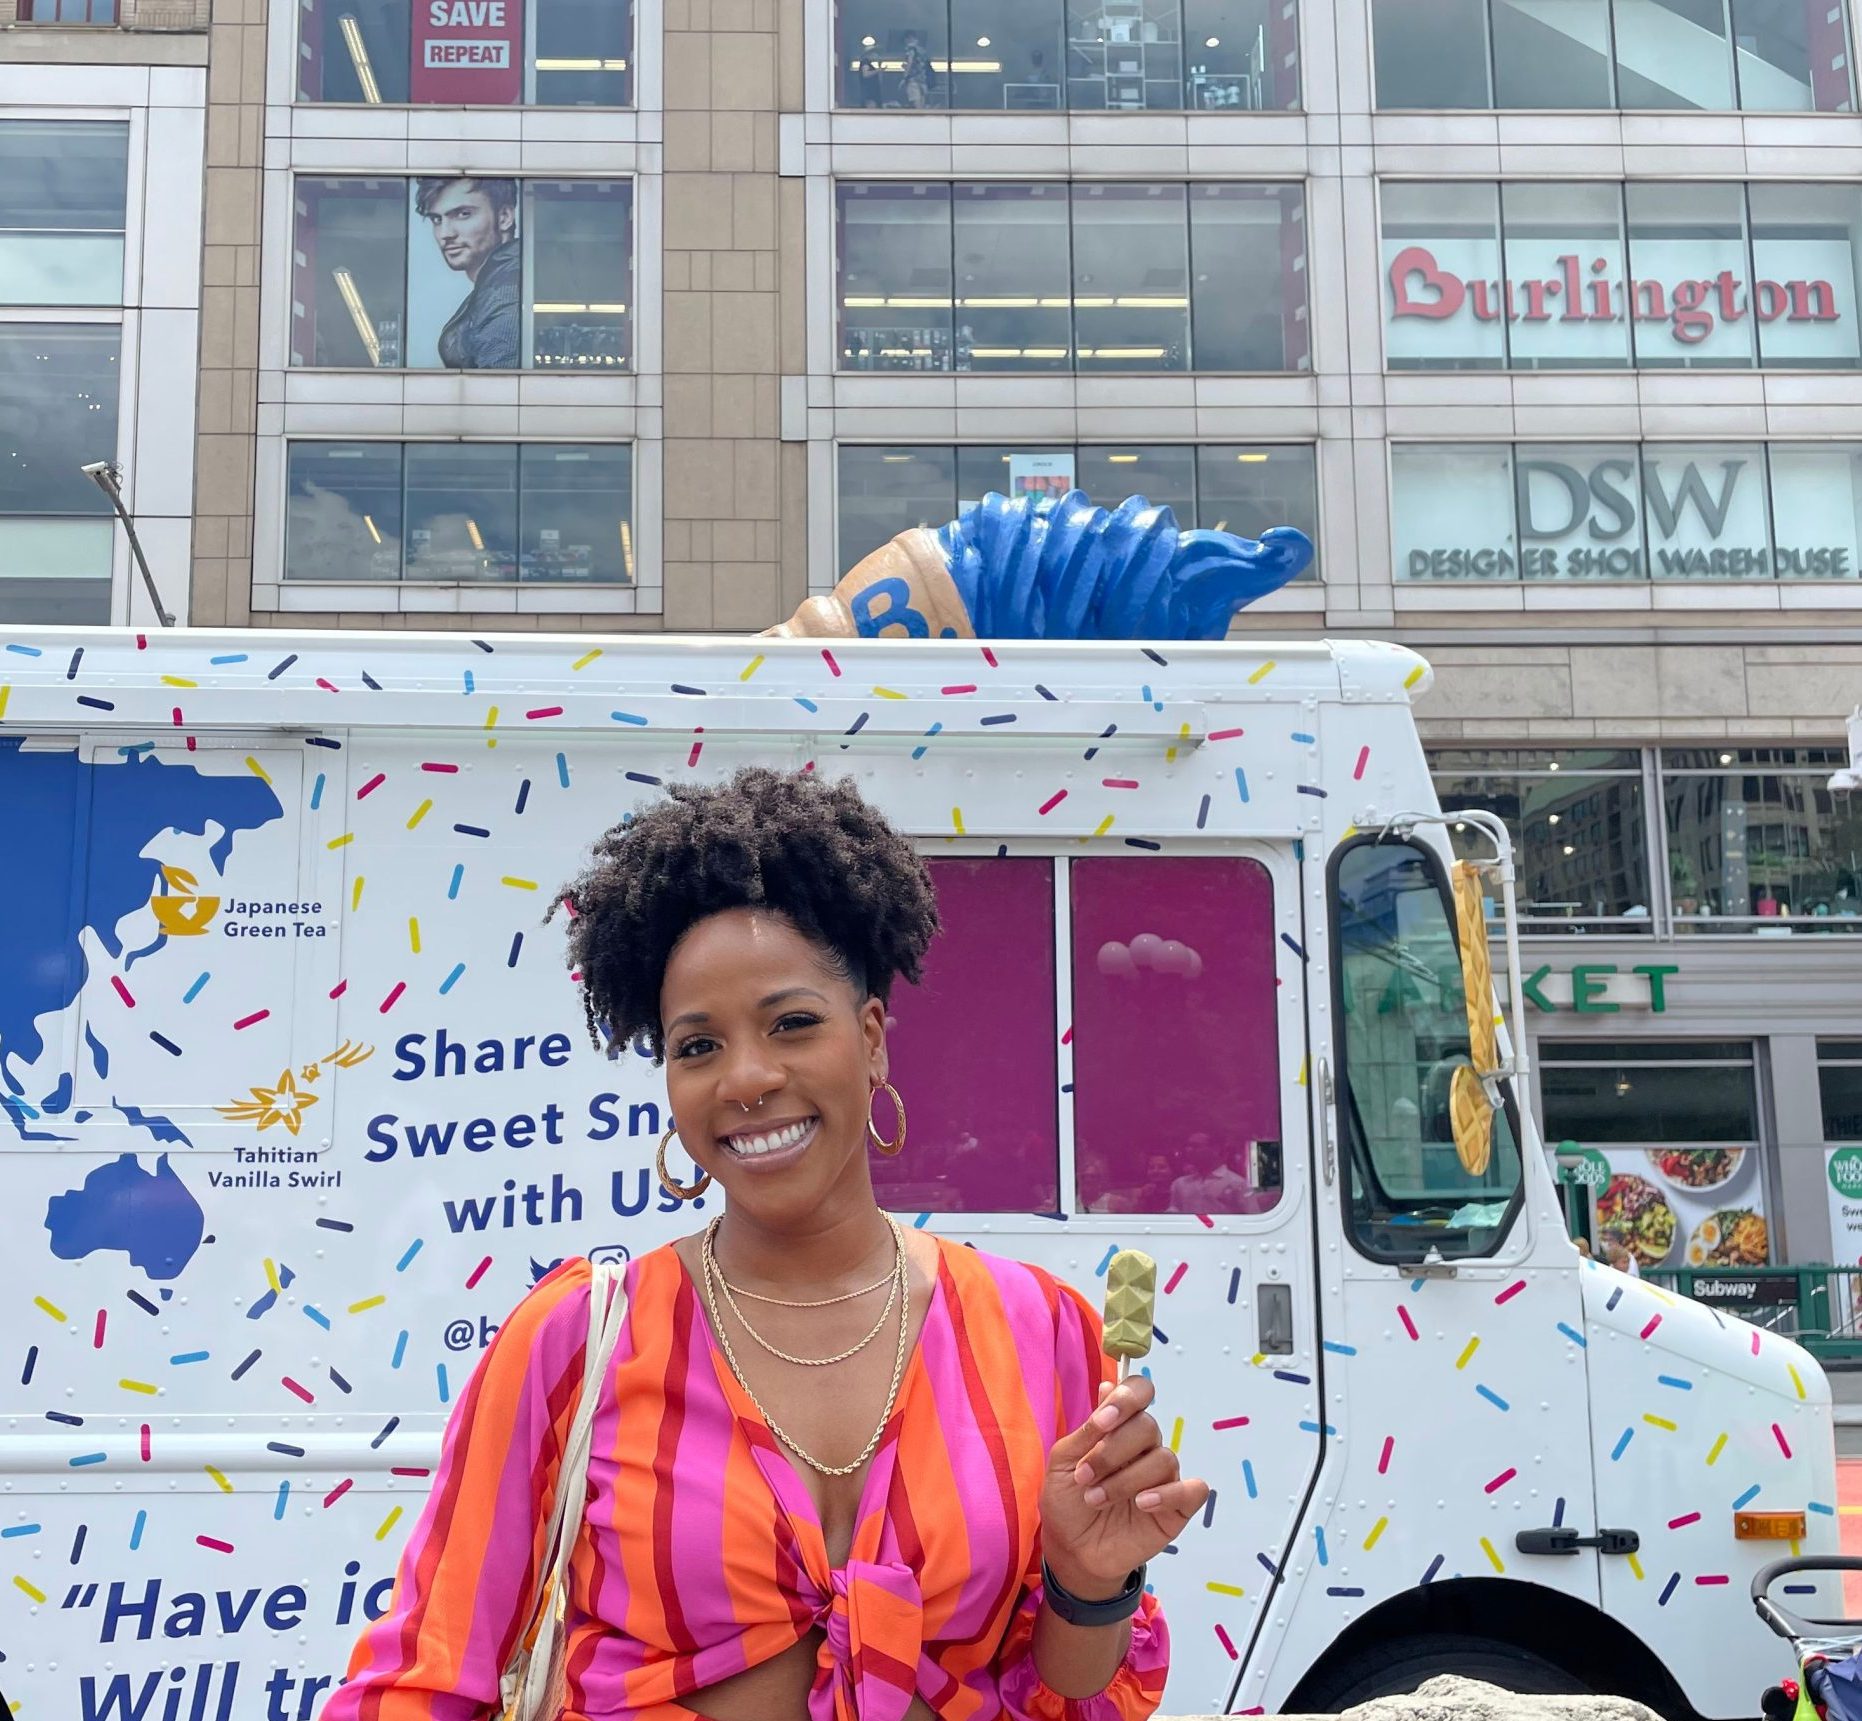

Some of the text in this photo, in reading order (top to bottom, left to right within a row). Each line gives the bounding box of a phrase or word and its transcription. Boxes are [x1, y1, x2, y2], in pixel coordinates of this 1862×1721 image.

[430, 1, 506, 27] SAVE
[430, 45, 504, 63] REPEAT
[1390, 246, 1841, 344] Burlington
[1503, 459, 1748, 541] DSW
[1408, 548, 1559, 578] DESIGNER
[1657, 546, 1851, 577] WAREHOUSE
[224, 898, 322, 918] Japanese
[223, 922, 327, 938] Green Tea
[392, 1028, 572, 1081] Share
[364, 1092, 674, 1163] Sweet Sn
[234, 1147, 318, 1164] Tahitian
[208, 1171, 342, 1188] Vanilla Swirl
[443, 1173, 583, 1233] with
[1693, 1278, 1756, 1299] Subway
[444, 1315, 499, 1351] @b
[80, 1661, 348, 1721] Will tr
